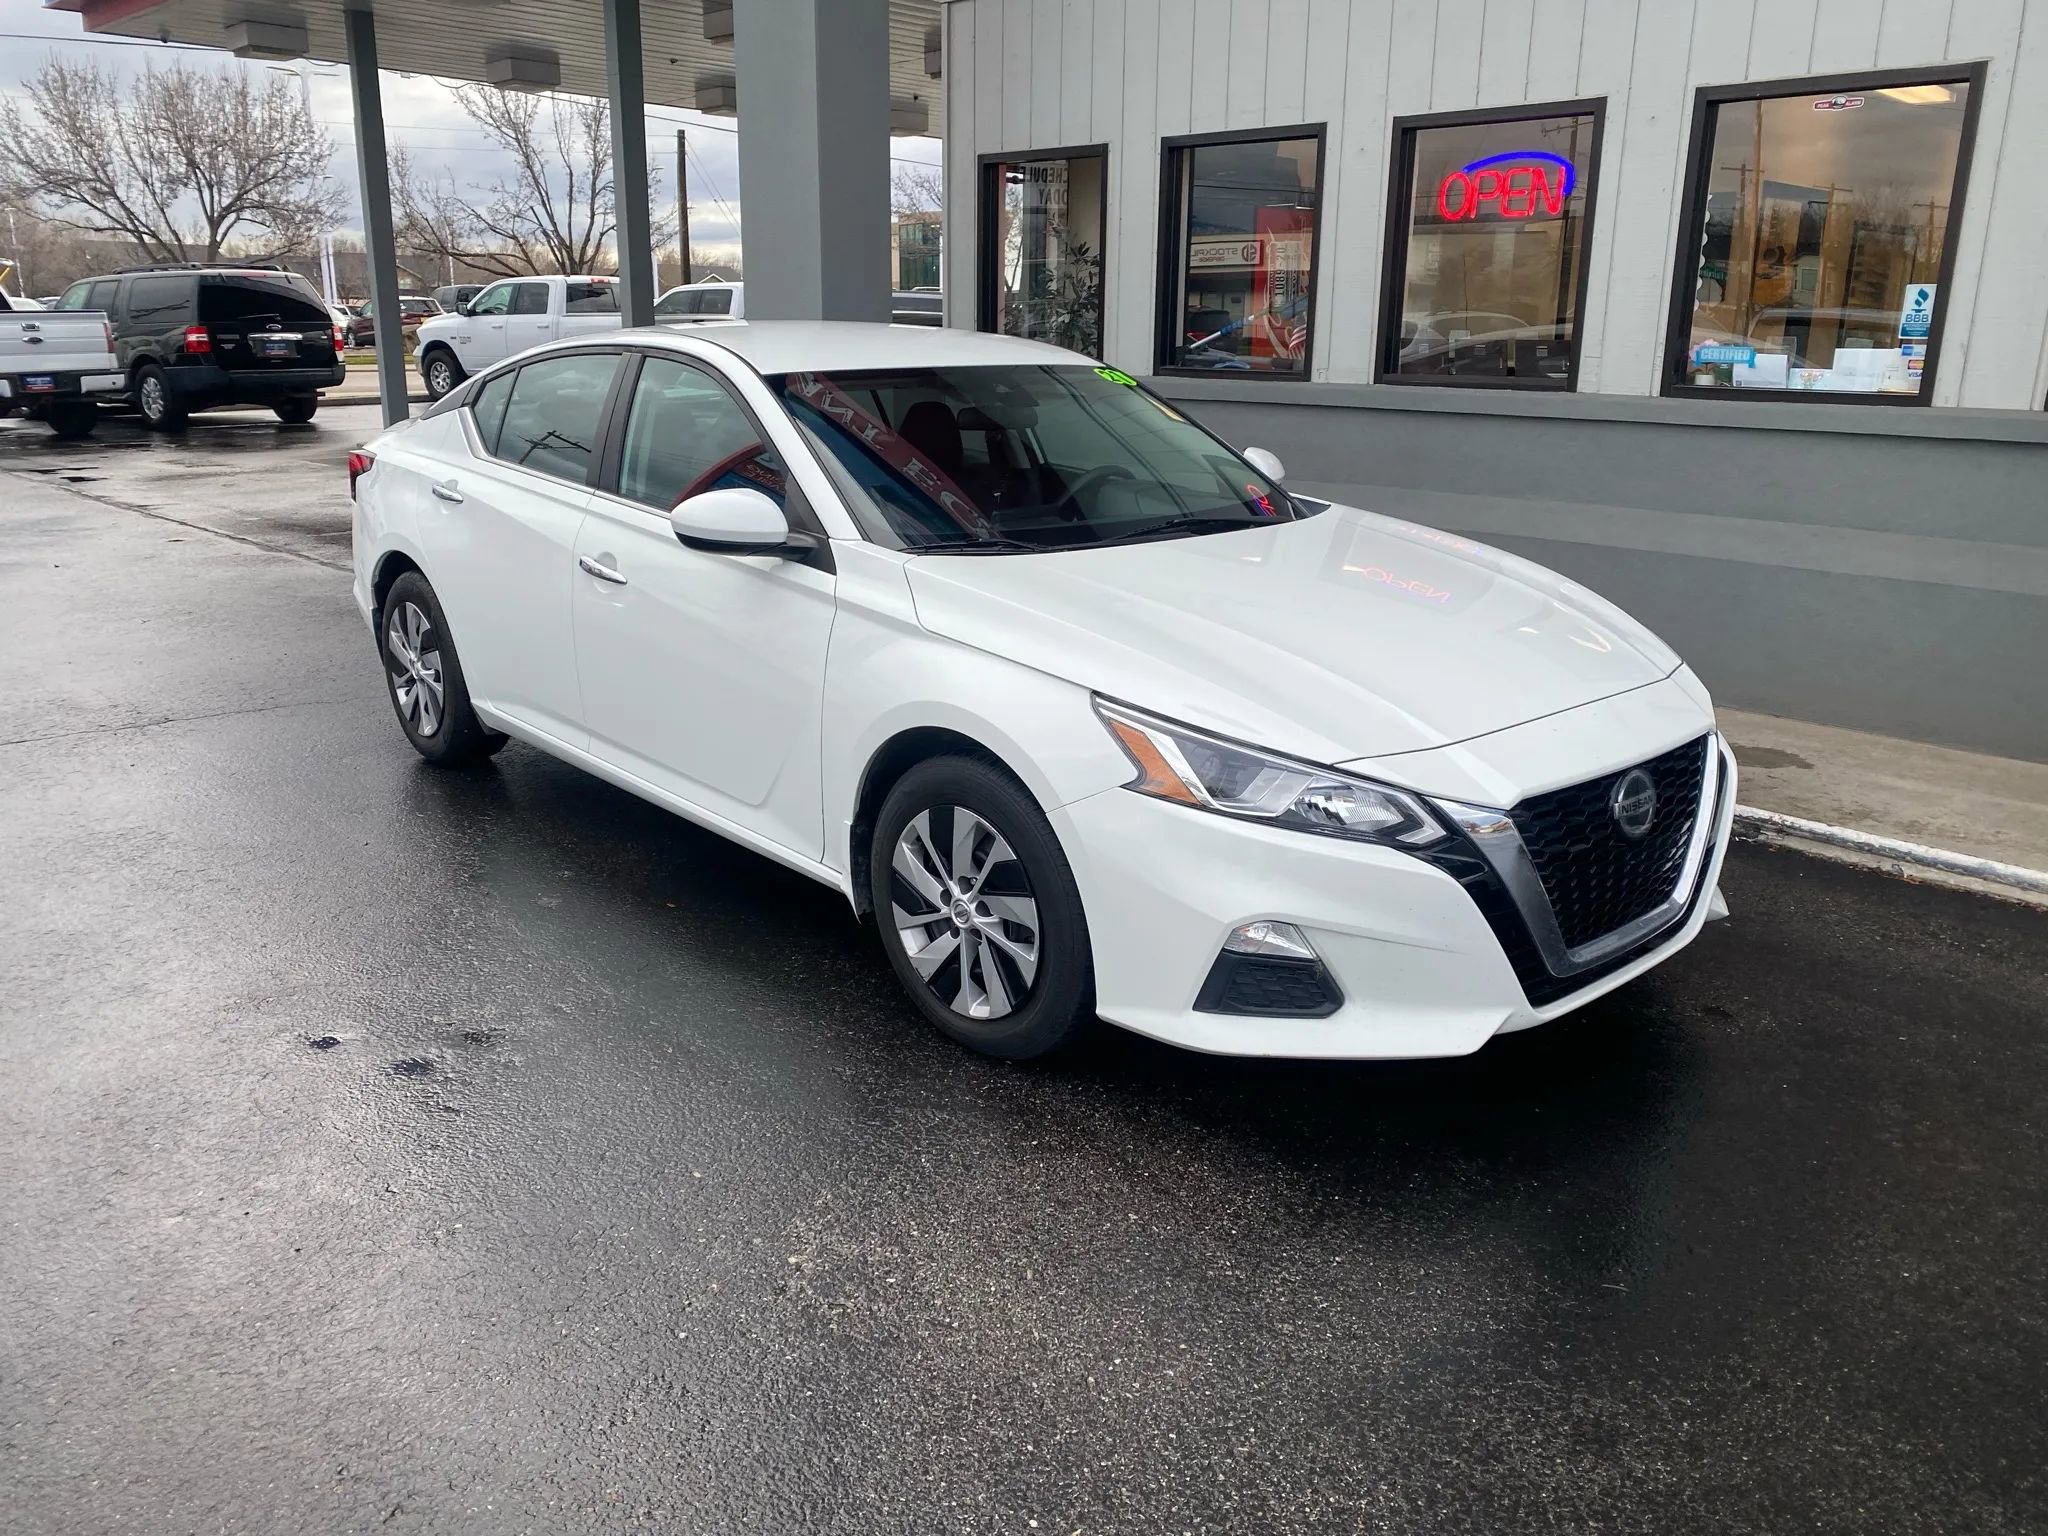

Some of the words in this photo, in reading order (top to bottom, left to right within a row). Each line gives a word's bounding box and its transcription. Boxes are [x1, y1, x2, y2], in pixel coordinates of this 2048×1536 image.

[1439, 166, 1566, 220] OPEN
[1905, 314, 1929, 323] BBB
[1700, 348, 1751, 361] CERTIFIED
[1621, 794, 1652, 815] NISSAN
